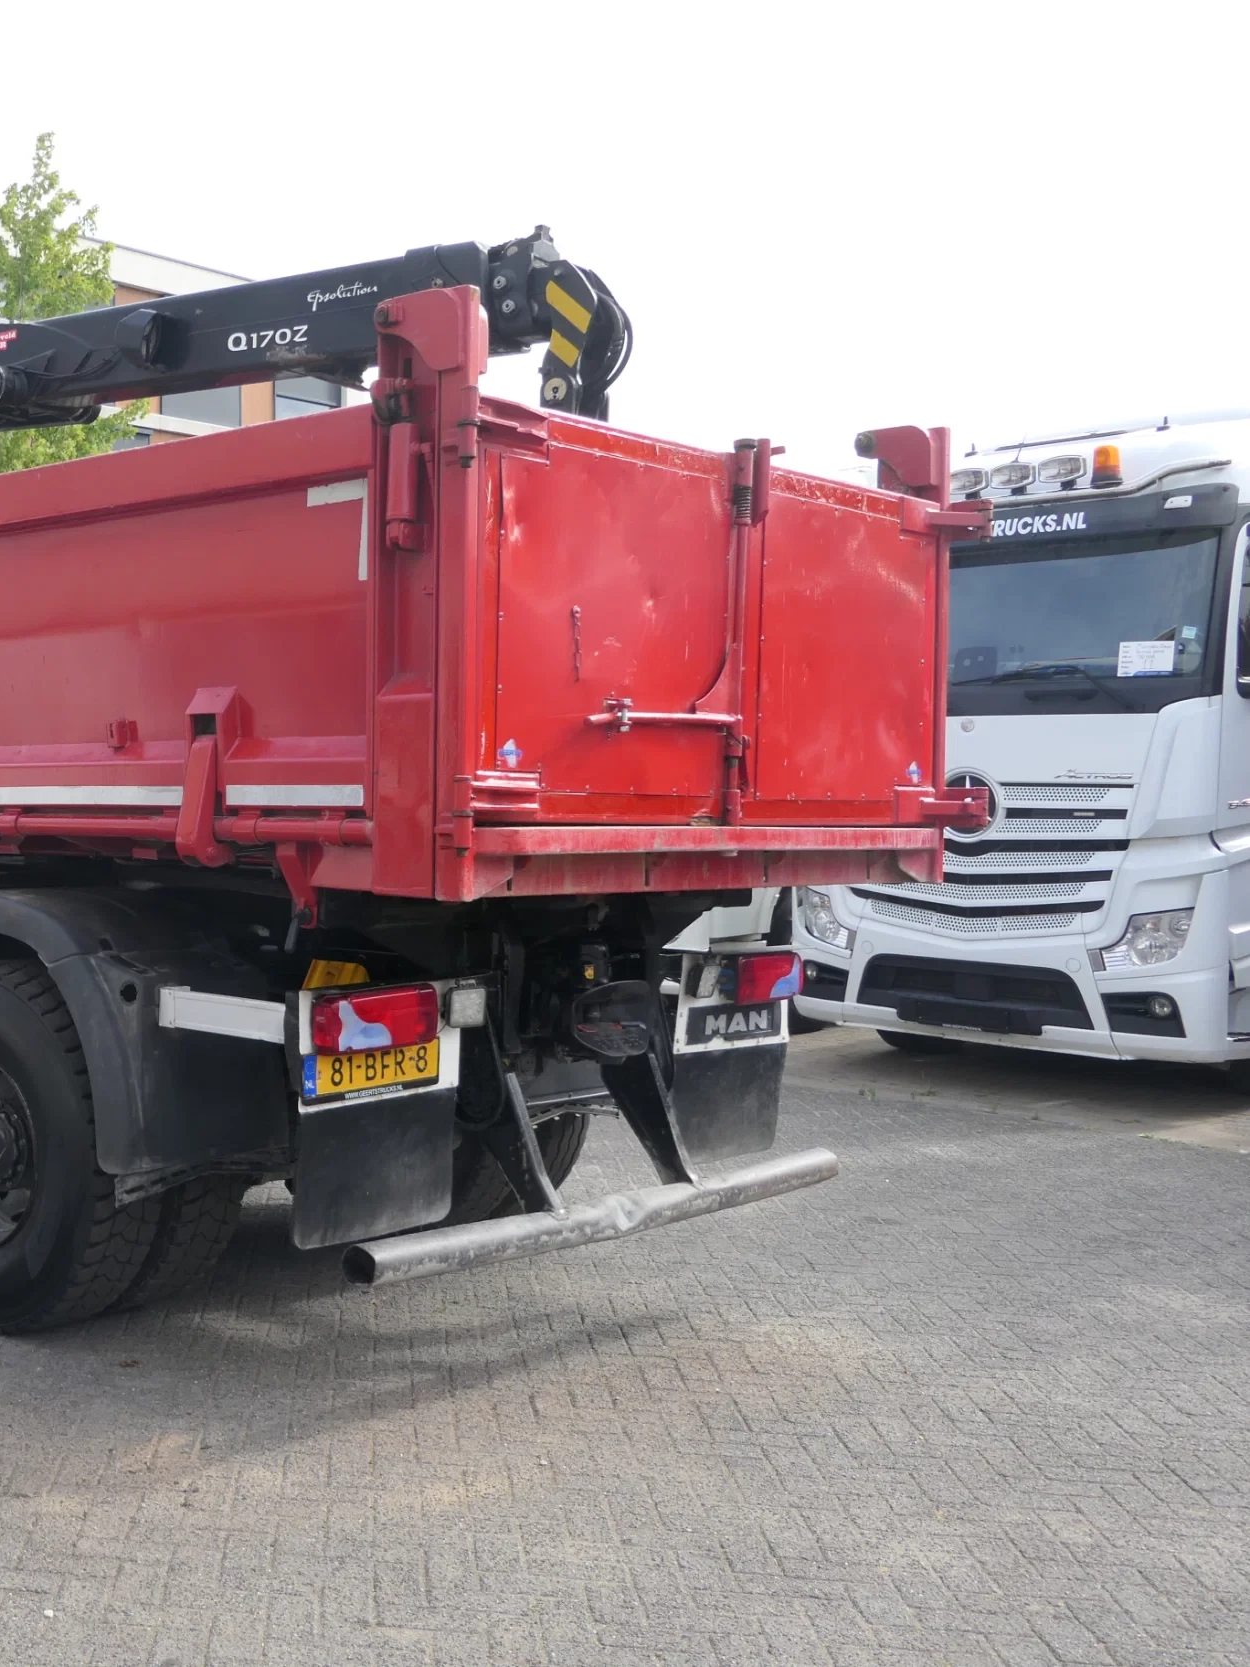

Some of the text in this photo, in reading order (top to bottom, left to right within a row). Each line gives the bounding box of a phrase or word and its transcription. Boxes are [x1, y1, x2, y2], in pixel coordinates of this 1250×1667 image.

[307, 281, 379, 312] Epsolution
[227, 325, 308, 352] Q170Z
[704, 1009, 769, 1036] MAN
[330, 1045, 428, 1087] 81-BFR-8
[304, 1079, 316, 1091] NL
[344, 1084, 404, 1100] WWW.GEERTSTRUCKS.NL
